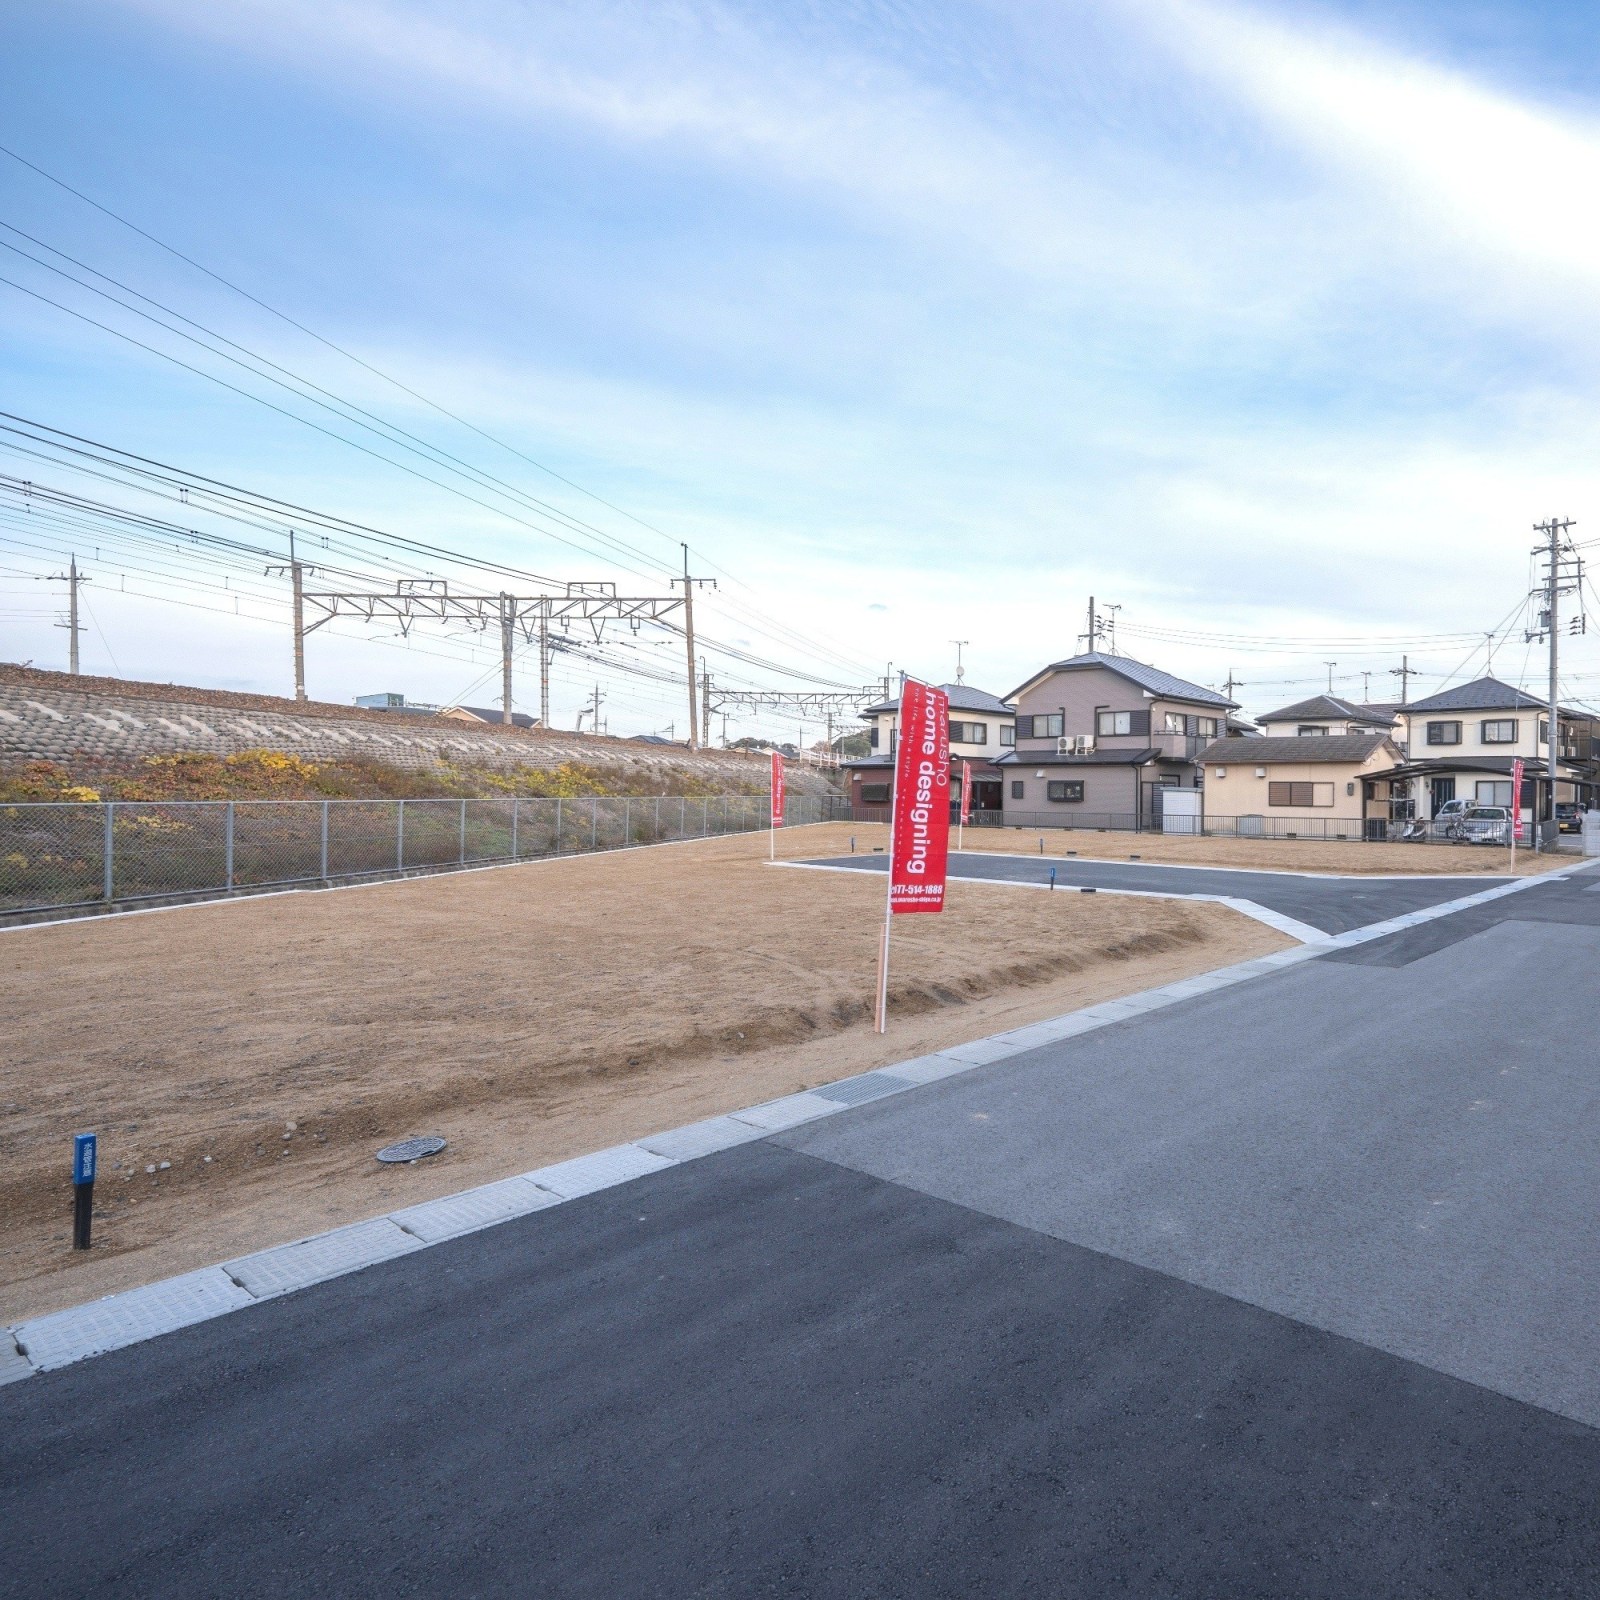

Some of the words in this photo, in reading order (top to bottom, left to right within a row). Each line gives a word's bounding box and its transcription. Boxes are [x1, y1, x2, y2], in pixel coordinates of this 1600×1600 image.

[922, 691, 936, 755] home
[936, 696, 949, 786] marusho
[907, 761, 935, 874] designing
